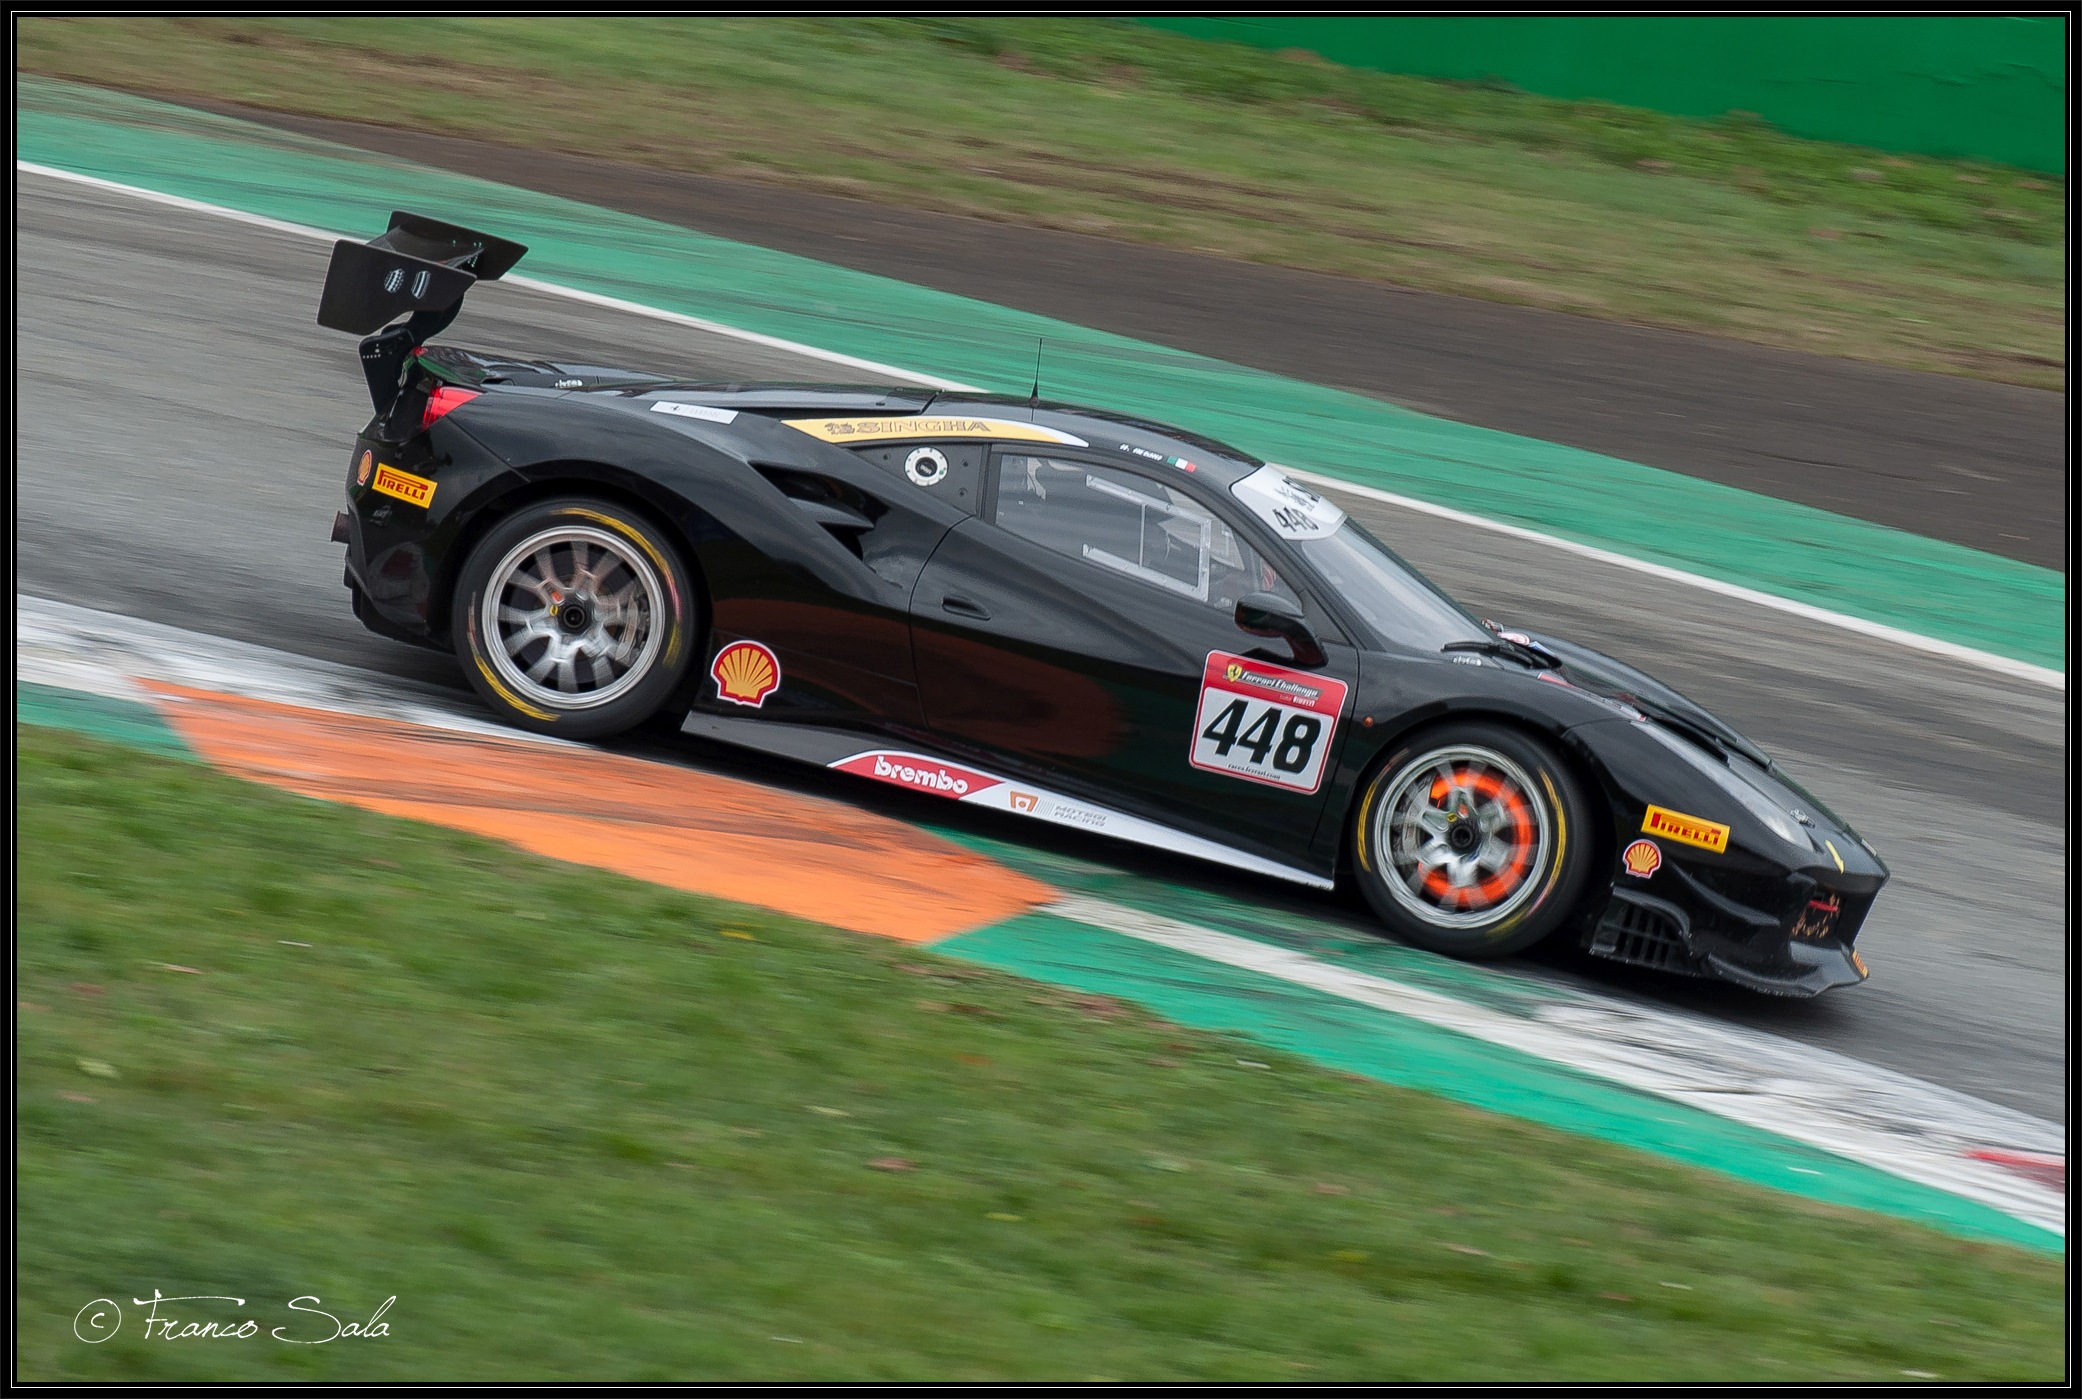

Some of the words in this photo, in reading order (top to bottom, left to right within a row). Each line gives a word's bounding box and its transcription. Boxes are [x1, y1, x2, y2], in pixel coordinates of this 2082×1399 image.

[856, 420, 991, 434] SINGHA
[377, 469, 429, 501] PIRELLI
[1272, 505, 1319, 533] 448
[1242, 671, 1275, 687] Ferrari
[1202, 698, 1322, 775] 448
[874, 755, 968, 794] brembo
[1650, 811, 1722, 845] PIRELLI
